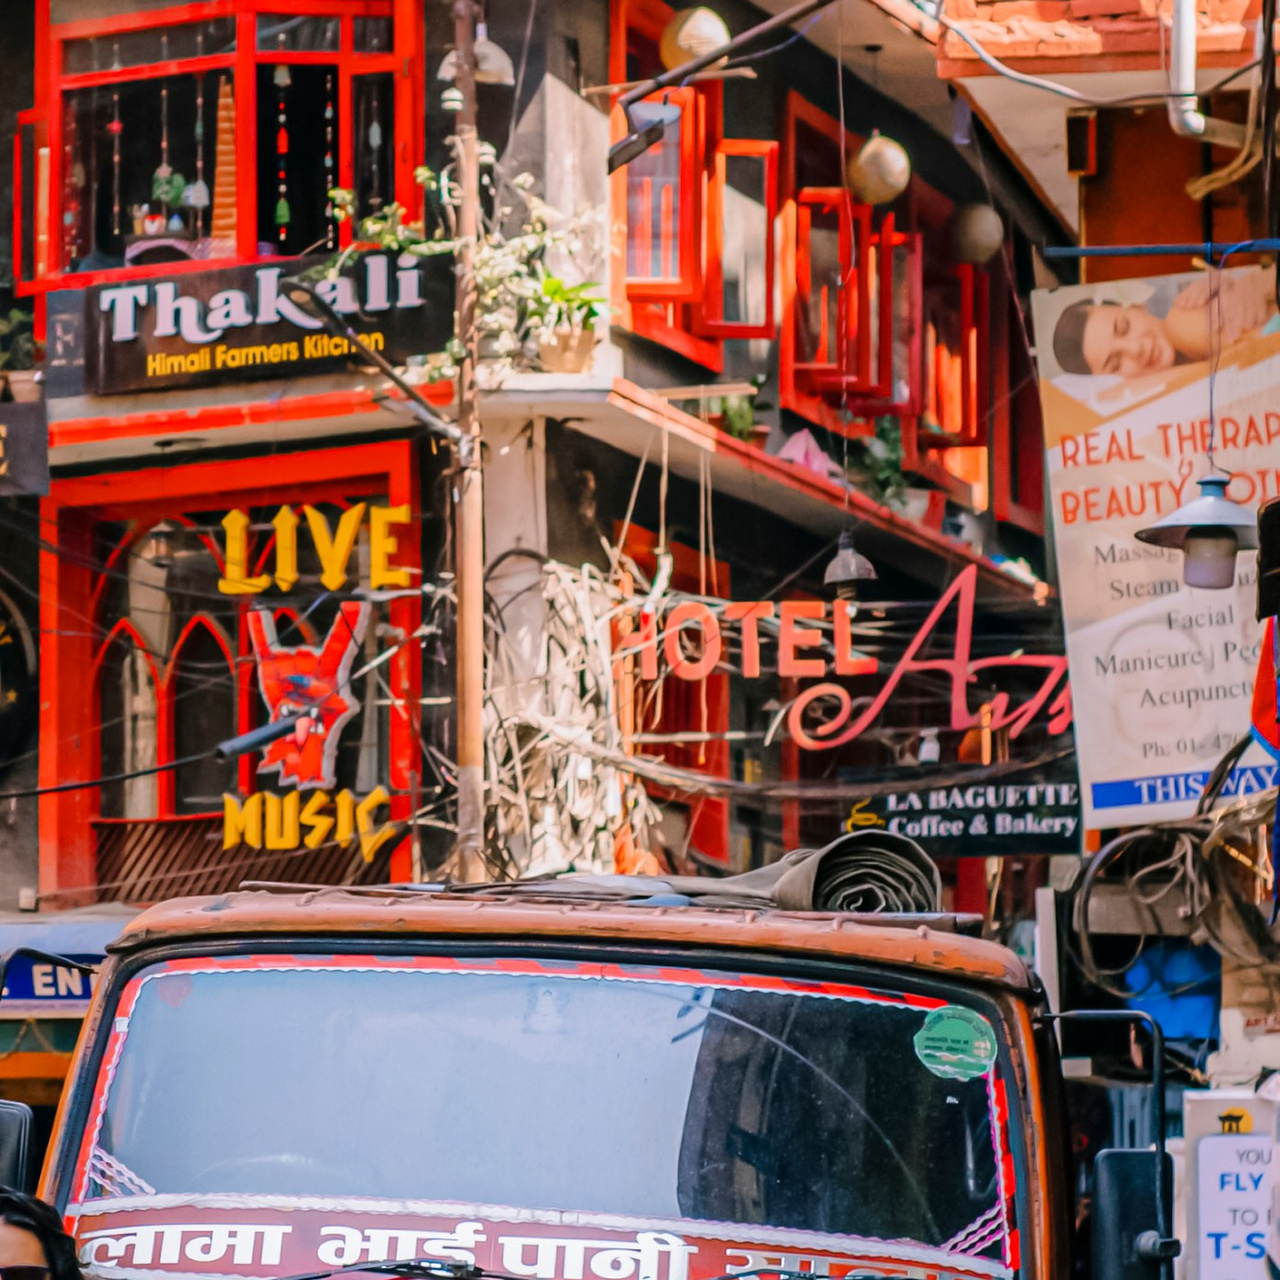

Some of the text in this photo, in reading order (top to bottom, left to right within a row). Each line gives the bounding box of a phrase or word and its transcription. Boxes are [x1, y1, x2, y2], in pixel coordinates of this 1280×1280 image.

[146, 346, 212, 378] Himali
[216, 340, 300, 370] Farmers
[1059, 428, 1145, 468] REAL
[1060, 457, 1194, 525] BEAUTY
[217, 502, 412, 596] LIVE
[1109, 578, 1180, 601] Steam
[1166, 604, 1235, 631] Facial
[611, 599, 879, 681] HOTEL
[1094, 650, 1203, 676] Manicure
[886, 783, 1079, 811] LA BAGUETTE
[1134, 773, 1206, 805] THIS
[222, 785, 398, 864] MUSIC
[888, 813, 1079, 838] Coffee & Bakery
[1219, 1172, 1265, 1192] FLY
[1228, 1208, 1260, 1227] TO
[78, 1221, 293, 1268] लामा
